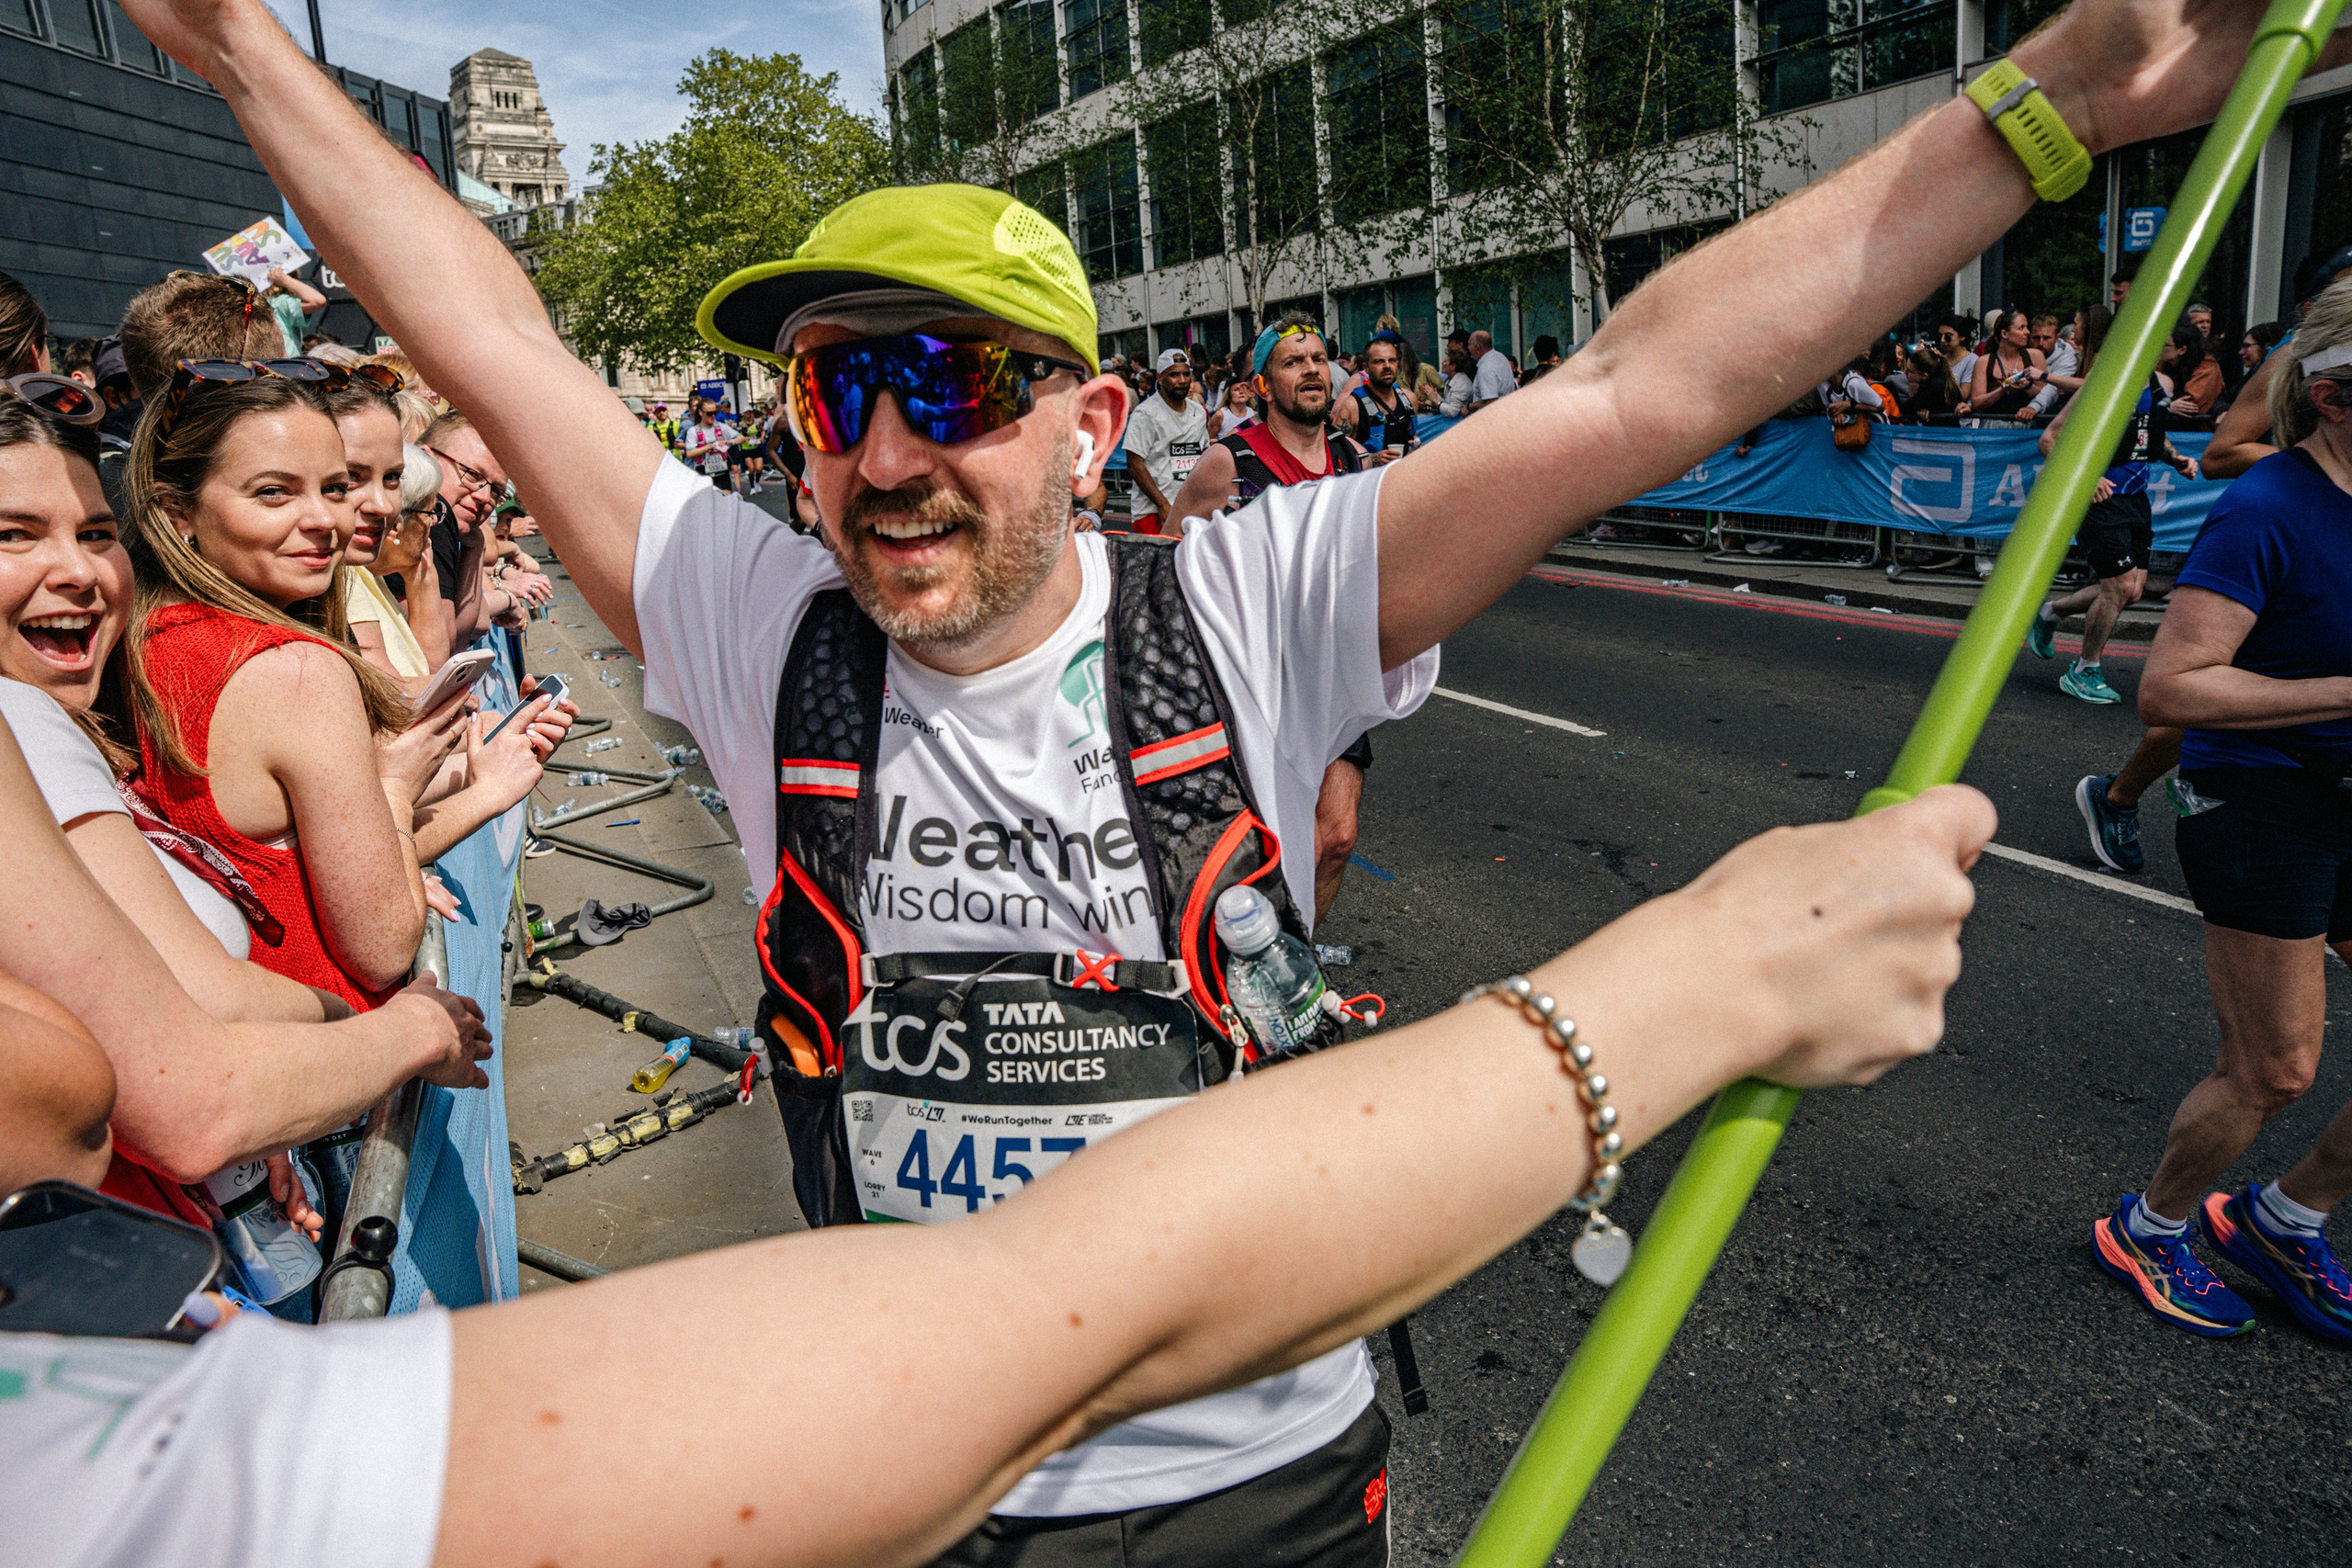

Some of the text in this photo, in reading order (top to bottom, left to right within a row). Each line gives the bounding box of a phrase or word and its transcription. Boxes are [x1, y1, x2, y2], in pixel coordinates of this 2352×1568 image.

[1175, 458, 1200, 469] 2113
[982, 1000, 1066, 1026] TATA
[984, 1022, 1171, 1055] CONSULTANCY
[860, 1011, 970, 1081] tcs
[986, 1056, 1106, 1084] SERVICES
[961, 1114, 1053, 1127] #WeRunTogether
[332, 1133, 347, 1141] DRY
[862, 1148, 882, 1158] WAVE
[864, 1181, 886, 1192] LORRY
